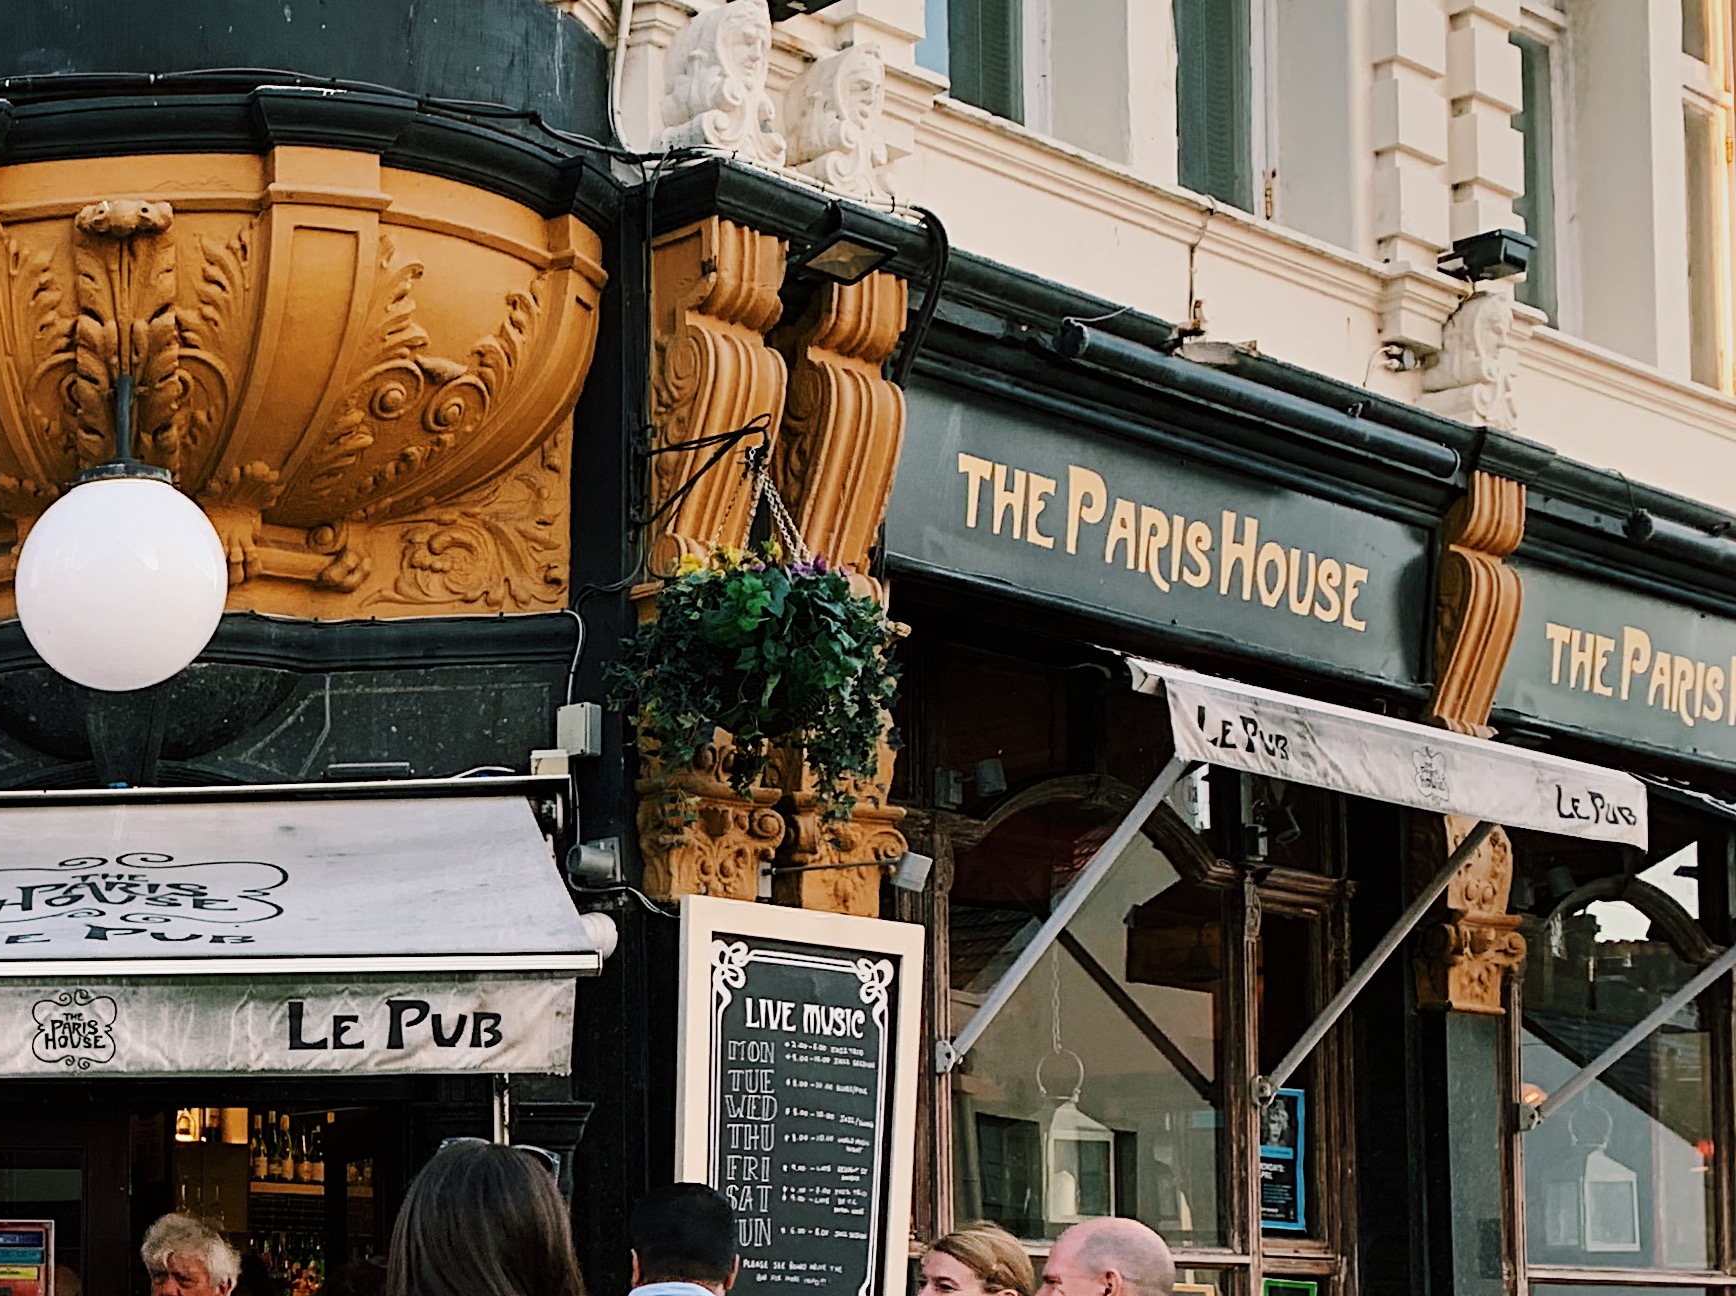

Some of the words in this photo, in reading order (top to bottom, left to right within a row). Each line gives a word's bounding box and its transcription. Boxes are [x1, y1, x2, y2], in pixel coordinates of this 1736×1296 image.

[957, 451, 1057, 550] THE
[1065, 463, 1212, 592] PARIS
[1219, 508, 1369, 632] HOUSE
[1545, 621, 1615, 697] THE
[1620, 625, 1725, 727] PARIS
[71, 873, 150, 883] THE
[15, 881, 208, 910] PARIS
[51, 1020, 98, 1038] PARIS
[63, 1012, 84, 1021] THE
[745, 997, 797, 1032] LIVE
[803, 1003, 866, 1039] MUSIC
[45, 1033, 106, 1049] HOUSE
[727, 1040, 775, 1064] MON
[727, 1069, 775, 1094] TUE
[724, 1094, 778, 1122] WED
[726, 1123, 775, 1152] THU
[726, 1155, 771, 1182] FRI
[725, 1185, 773, 1213] SAT
[734, 1218, 773, 1247] UN
[742, 1258, 768, 1269] PLEASE
